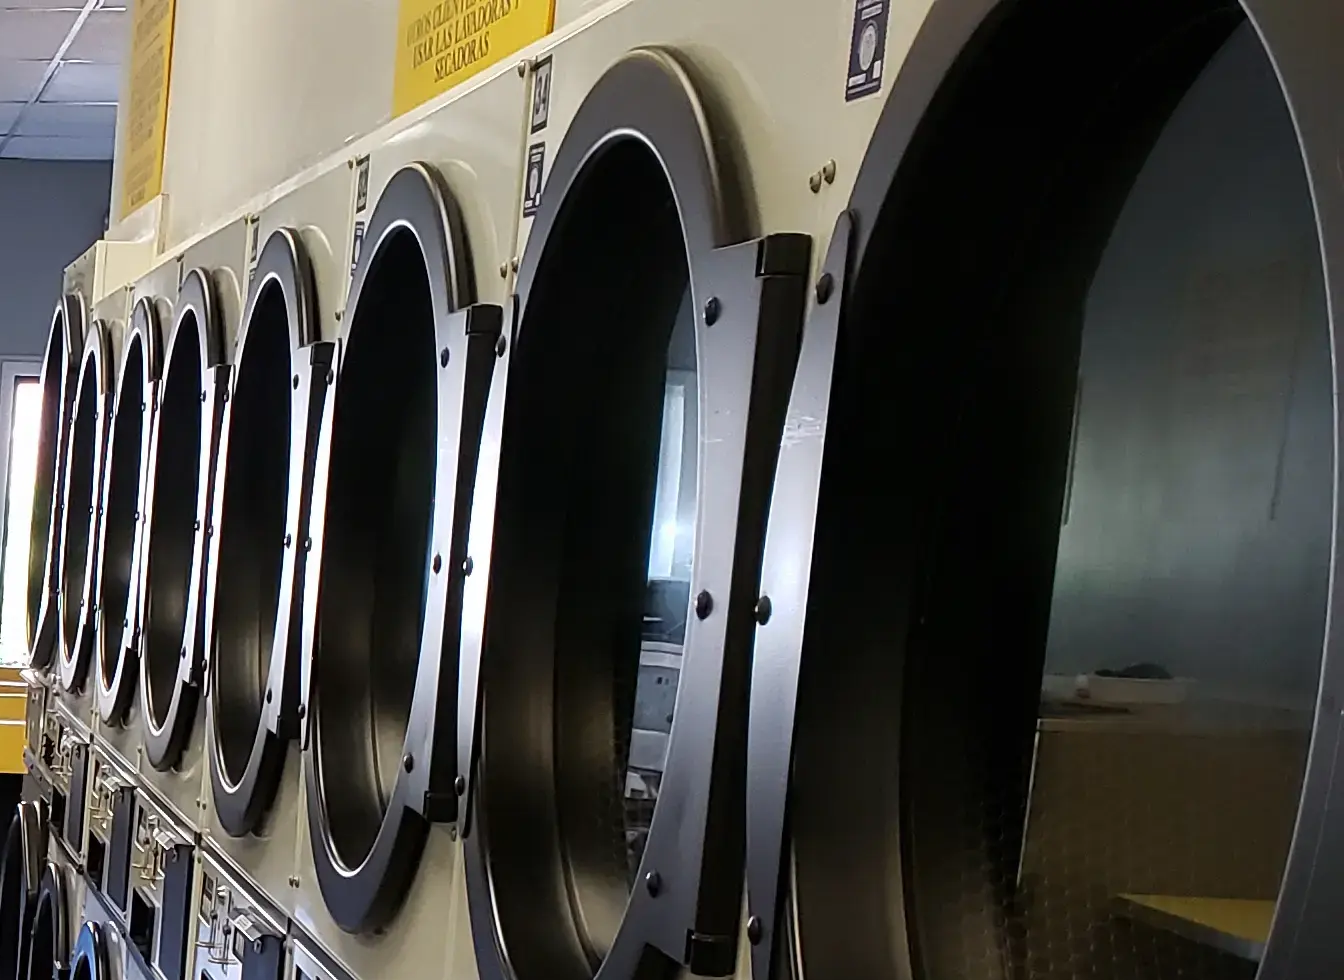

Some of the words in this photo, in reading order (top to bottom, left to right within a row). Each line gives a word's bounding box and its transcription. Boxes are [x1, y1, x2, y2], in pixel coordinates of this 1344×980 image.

[434, 31, 489, 83] SECADORAS
[436, 23, 452, 55] LAS
[536, 73, 549, 115] 34
